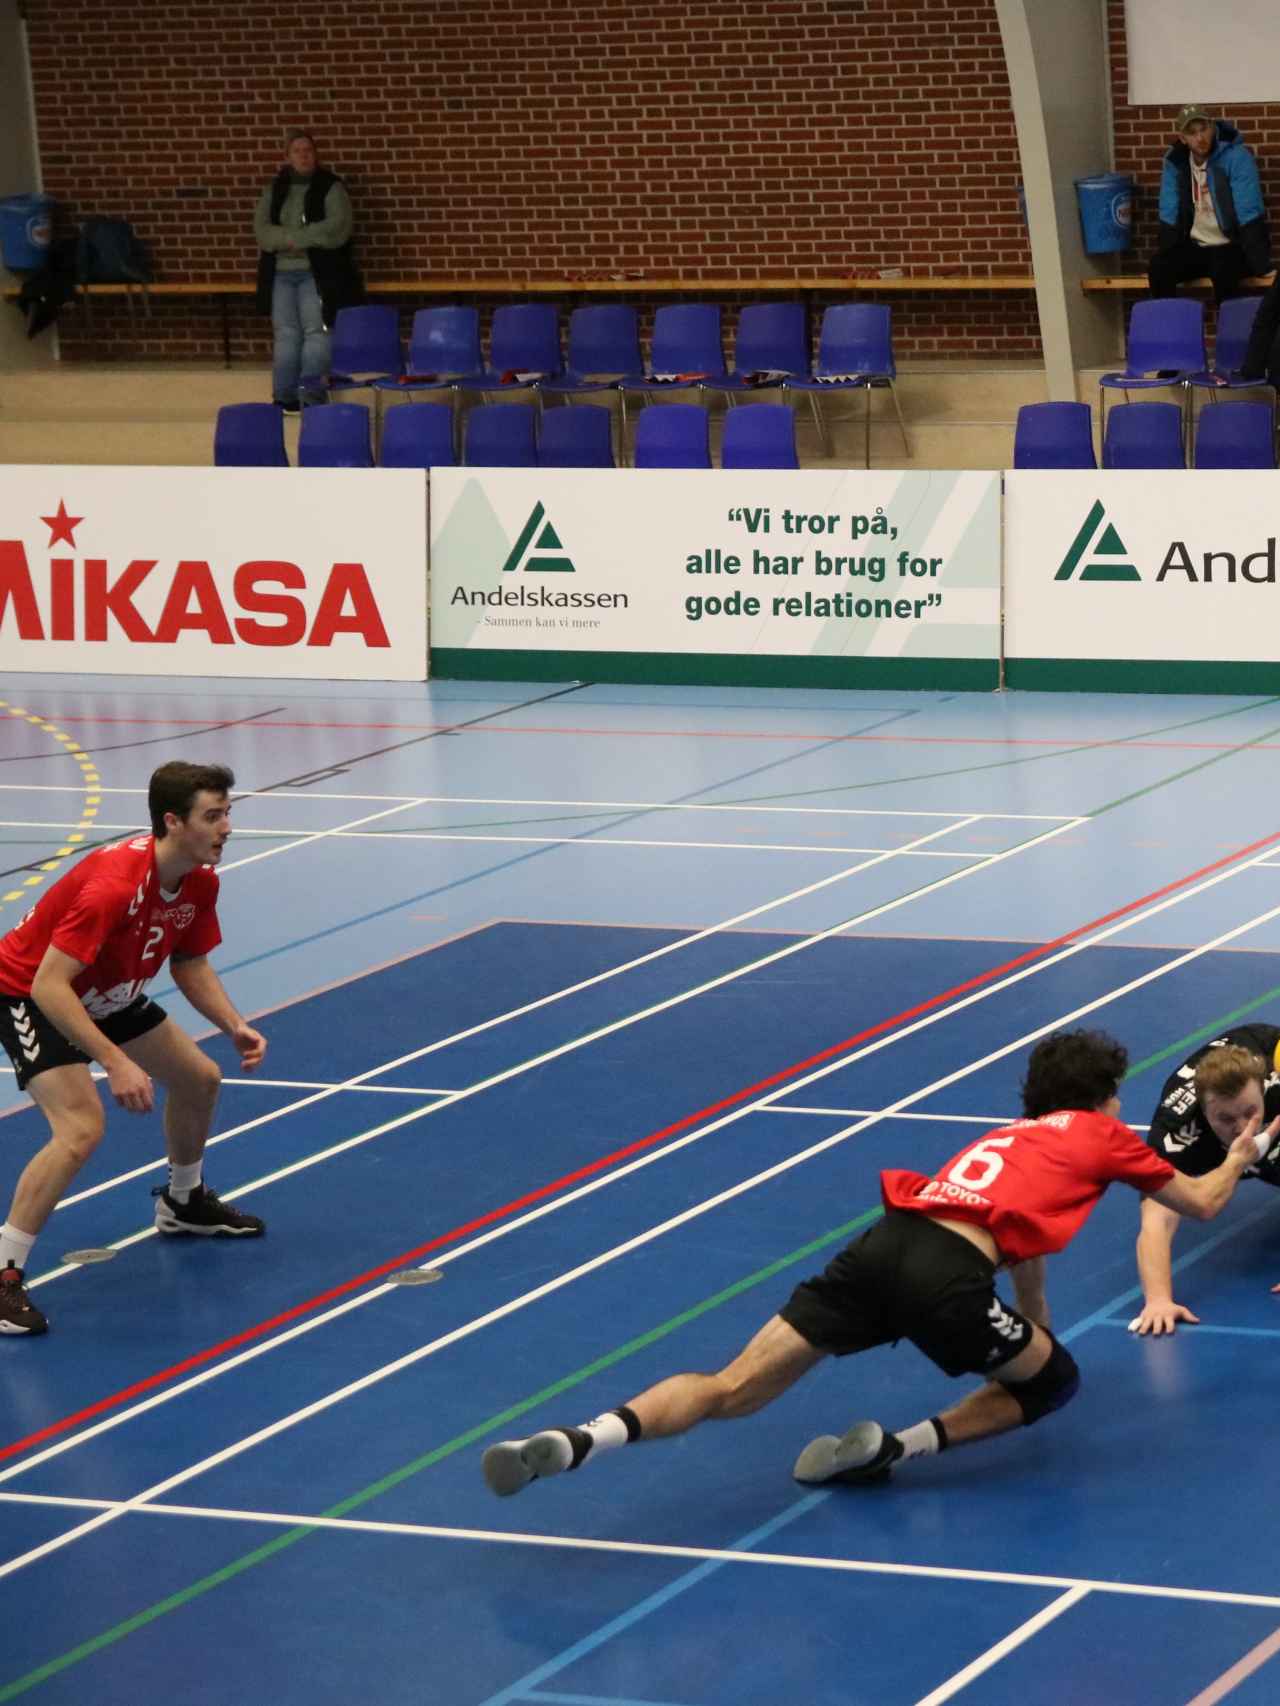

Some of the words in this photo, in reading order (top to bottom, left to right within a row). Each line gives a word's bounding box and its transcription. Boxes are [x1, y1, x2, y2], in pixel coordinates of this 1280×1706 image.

[782, 509, 840, 534] tror
[851, 506, 897, 540] på,
[686, 549, 741, 574] alle
[753, 549, 804, 575] har
[815, 550, 885, 582] brug
[897, 551, 942, 577] for
[451, 585, 628, 608] Andelskassen
[685, 591, 760, 621] gode
[484, 615, 532, 628] Sammen
[535, 616, 556, 628] kan
[558, 616, 569, 628] vi
[572, 618, 601, 629] mere
[142, 926, 165, 960] 2
[949, 1136, 1015, 1190] 6
